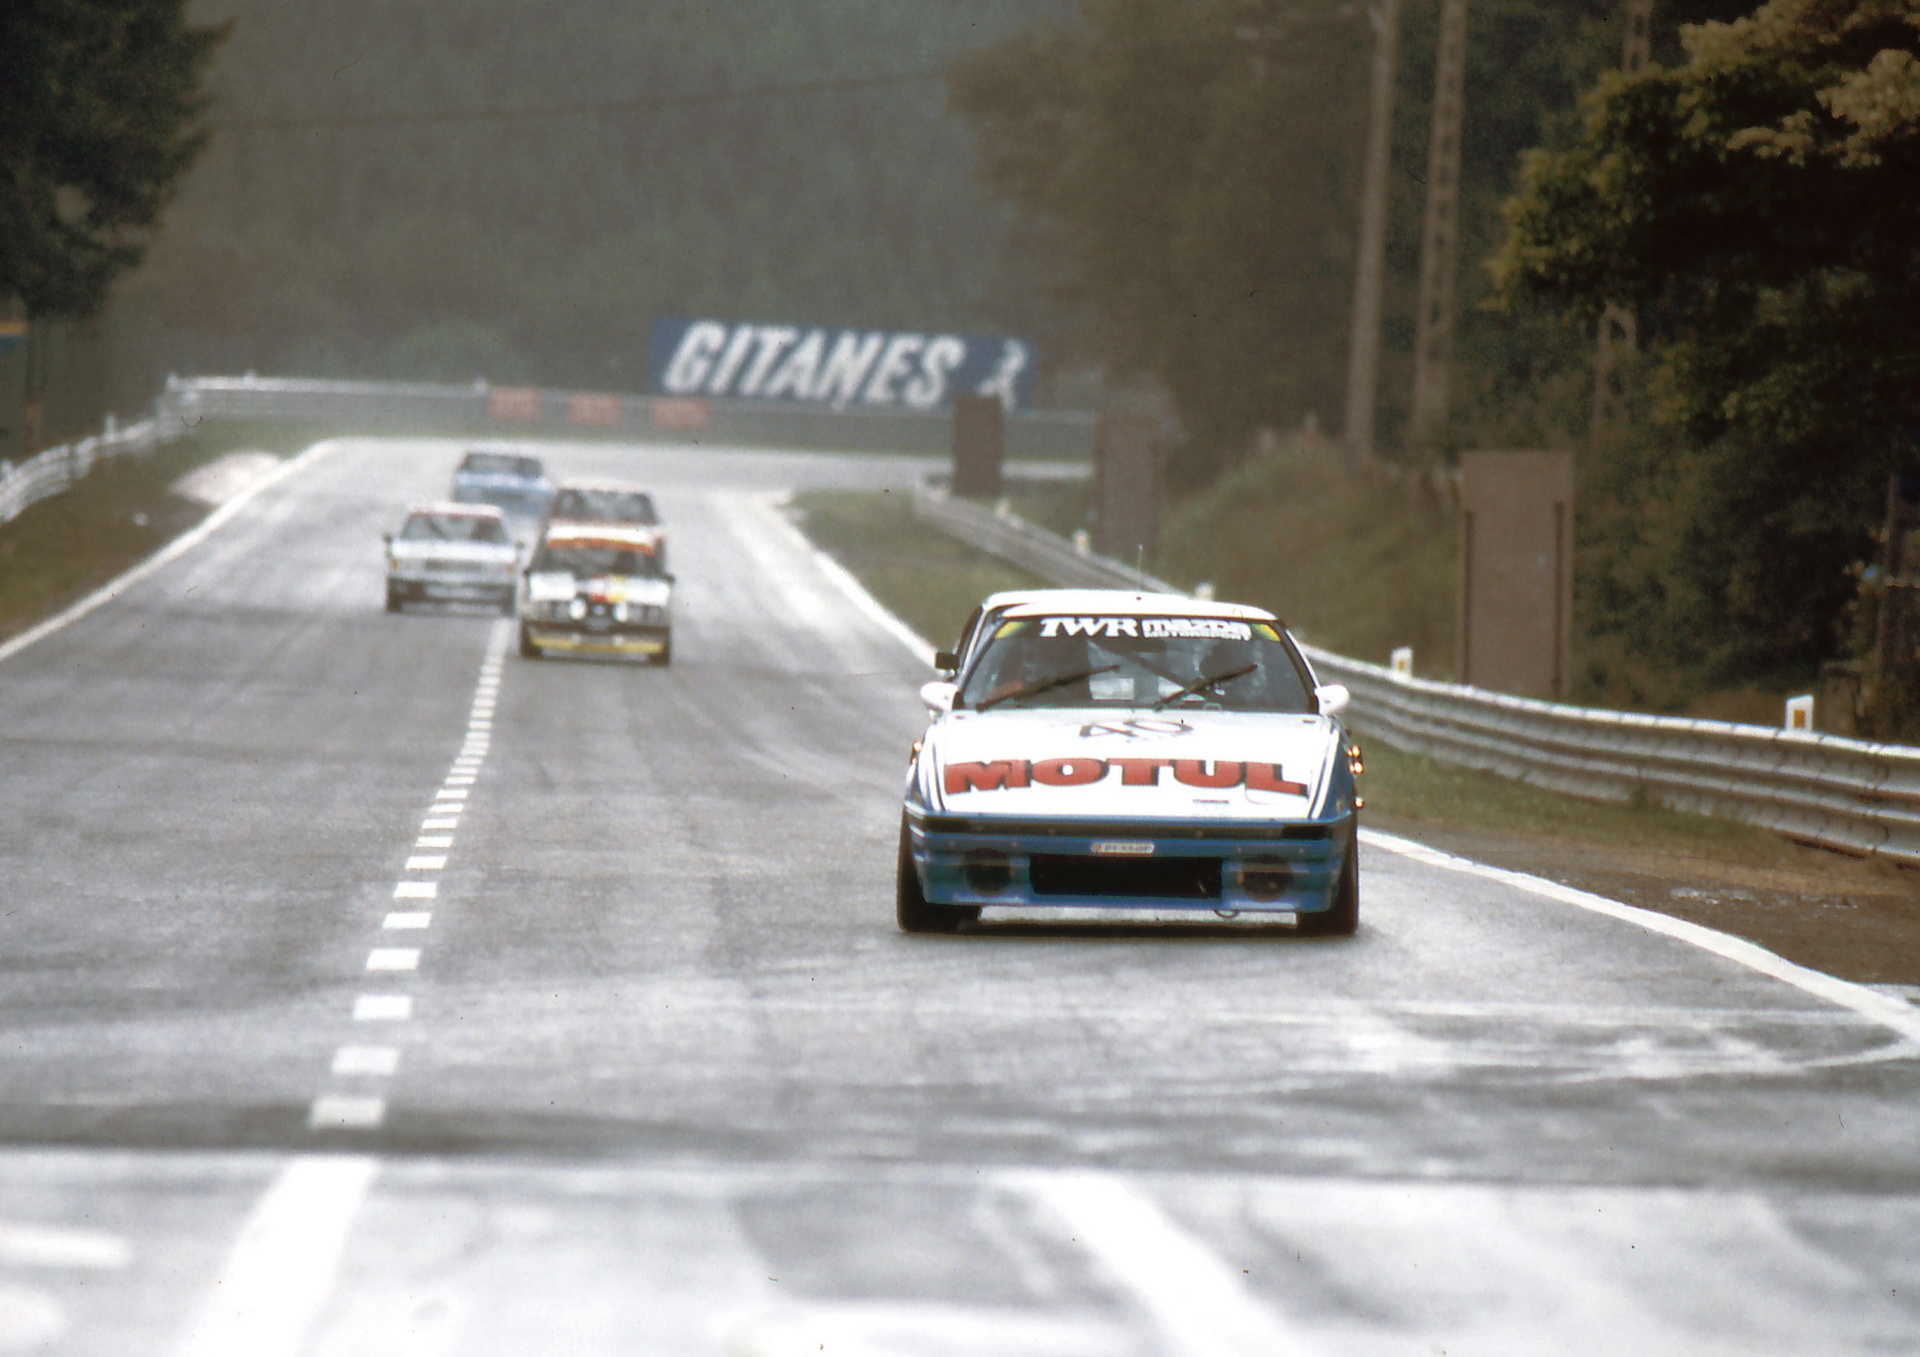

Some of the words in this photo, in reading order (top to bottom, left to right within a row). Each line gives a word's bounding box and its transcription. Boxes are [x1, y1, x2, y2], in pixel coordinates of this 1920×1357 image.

[663, 319, 966, 411] GITANES
[1040, 617, 1138, 637] TWR
[944, 757, 1308, 798] MOTUL
